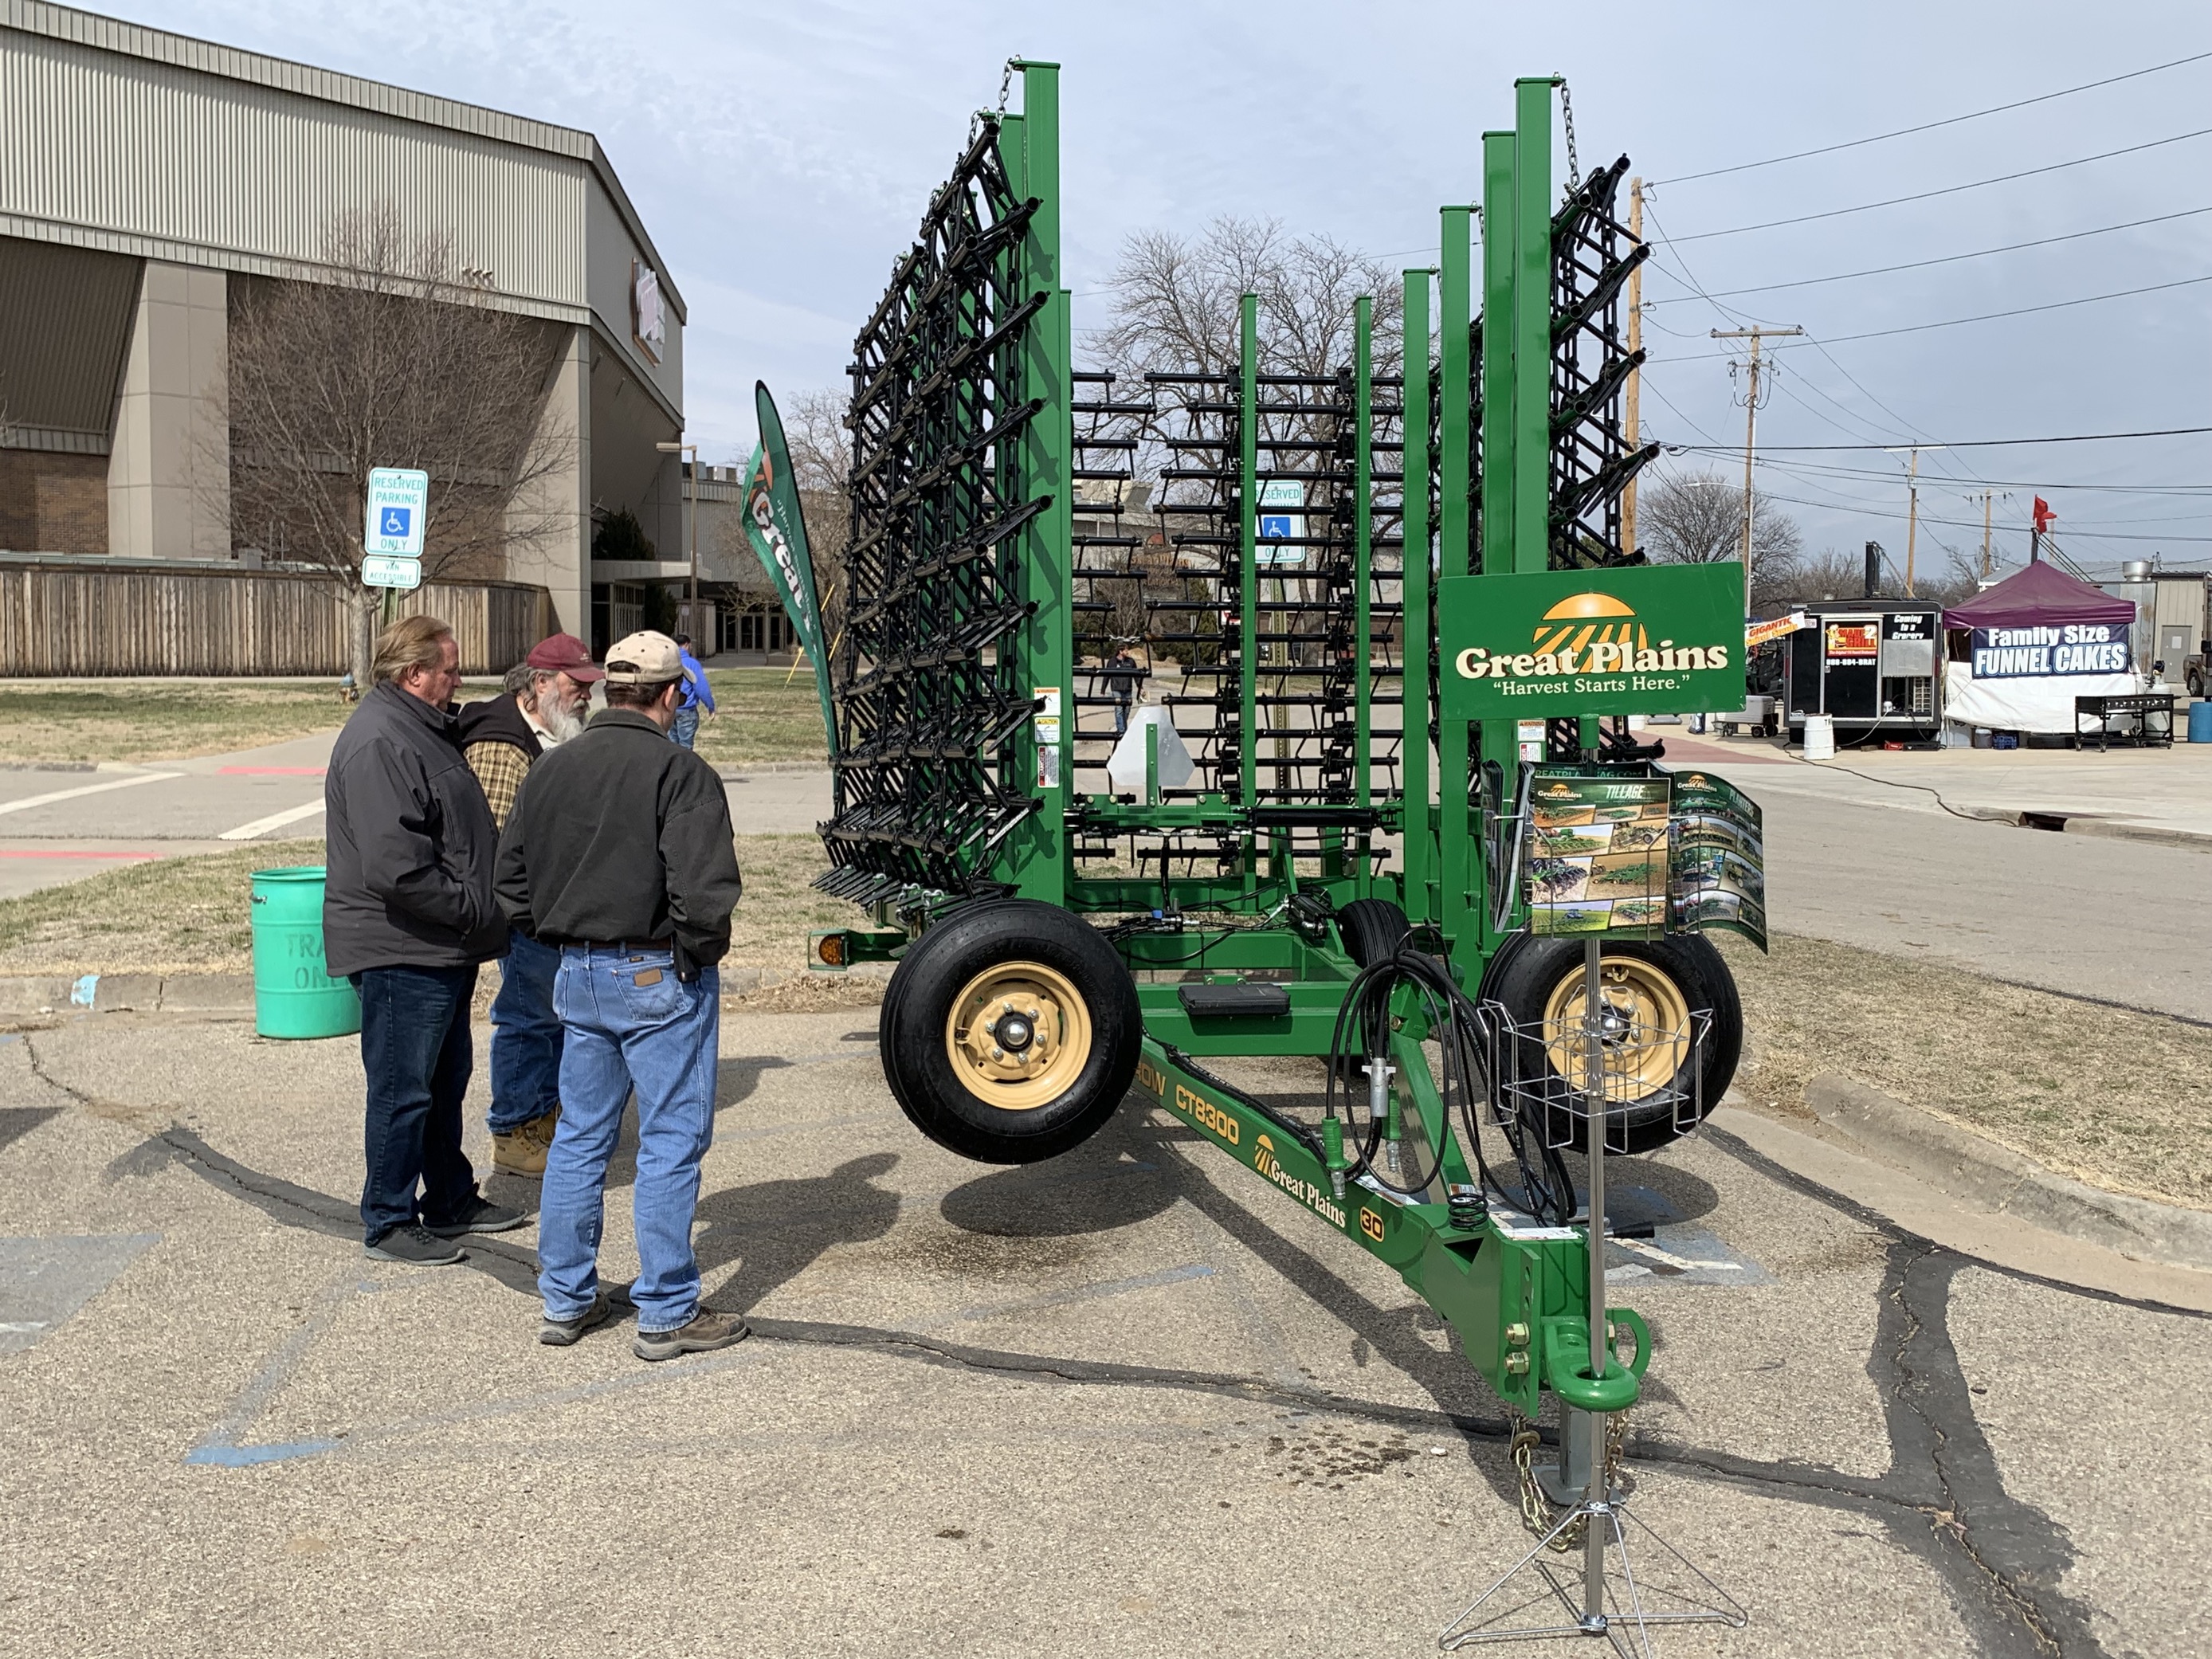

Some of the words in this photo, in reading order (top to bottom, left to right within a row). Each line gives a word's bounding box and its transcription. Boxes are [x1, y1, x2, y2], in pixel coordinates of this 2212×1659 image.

[375, 477, 424, 491] RESERVED
[375, 492, 418, 504] PARKING
[380, 538, 408, 551] ONLY
[370, 572, 413, 582] ACCESSIBLE
[1894, 614, 1923, 624] Coming
[1749, 617, 1792, 637] GIGANTIC
[1865, 625, 1877, 639] 2
[1845, 637, 1877, 647] GRILL
[1988, 626, 2061, 647] Family
[2064, 625, 2110, 645] Size
[1455, 645, 1581, 679] Great
[1589, 640, 1728, 673] Plains
[1975, 647, 2050, 674] FUNNEL
[2055, 643, 2126, 672] CAKES
[1574, 677, 1626, 693] Starts
[1606, 785, 1645, 799] TILLAGE
[1175, 1084, 1239, 1146] CT8300
[1270, 1160, 1304, 1200] Great
[1306, 1182, 1346, 1229] Plains
[1361, 1209, 1382, 1239] 30
